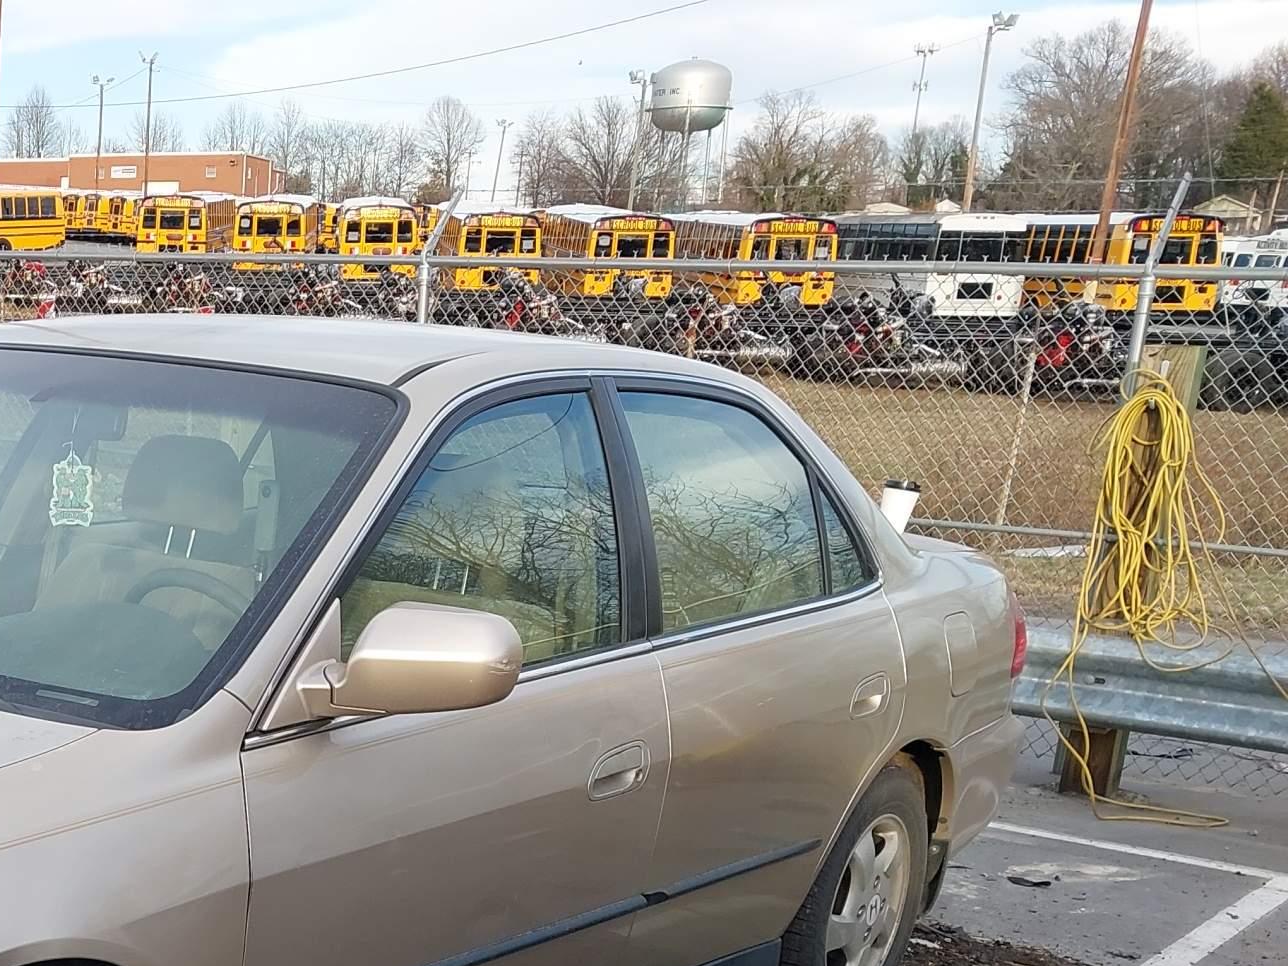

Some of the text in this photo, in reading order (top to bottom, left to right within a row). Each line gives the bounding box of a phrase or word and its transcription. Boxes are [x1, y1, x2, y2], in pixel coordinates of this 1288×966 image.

[614, 220, 656, 230] SCHOOL BUS
[773, 222, 817, 232] SCHOOL BUS
[1154, 219, 1202, 231] SCOL BUS
